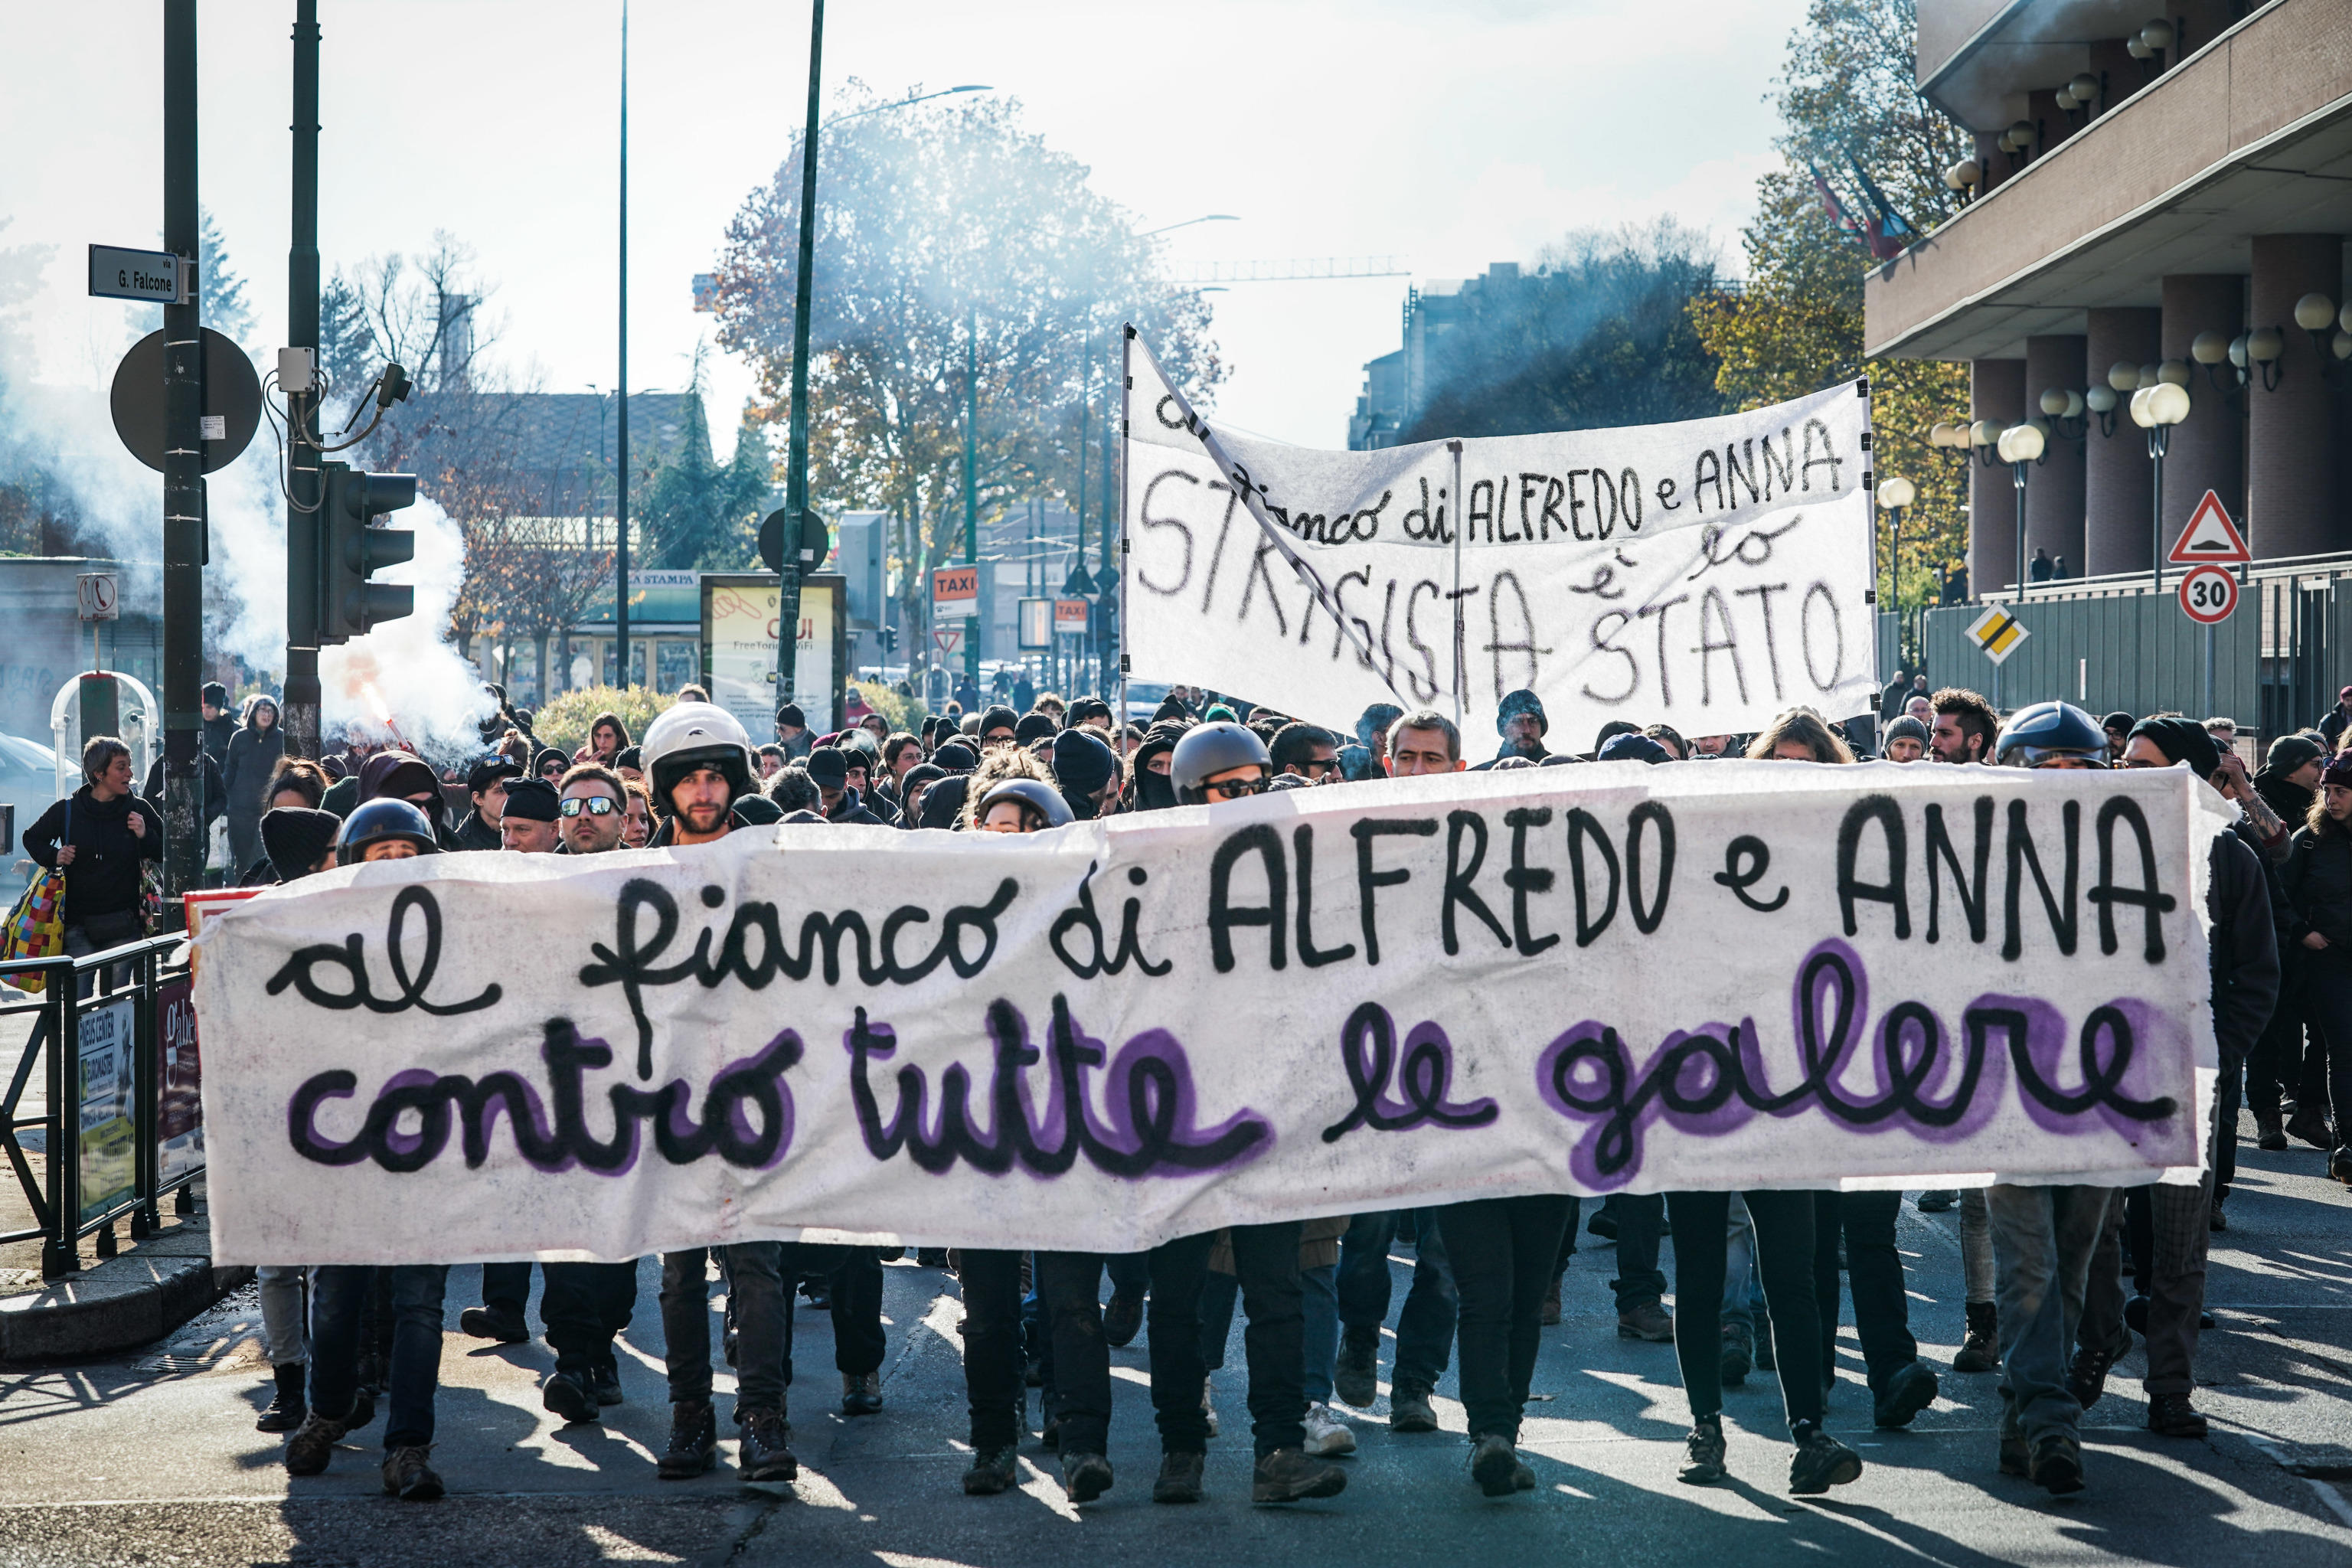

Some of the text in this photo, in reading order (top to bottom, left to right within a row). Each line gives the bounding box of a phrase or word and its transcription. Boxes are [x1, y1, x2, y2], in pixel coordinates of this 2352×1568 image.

[119, 270, 172, 292] G. Falcone
[1403, 477, 1454, 544] di
[1468, 467, 1642, 543] ALFREDO
[1655, 478, 1681, 510] e
[1694, 418, 1843, 513] ANNA
[1687, 514, 1804, 581] lo
[644, 575, 694, 585] STAMPA
[937, 577, 975, 593] TAXI
[2193, 581, 2226, 607] 30
[1058, 606, 1085, 616] TAXI
[1582, 580, 1844, 707] STATO
[266, 794, 2176, 1080] al fianco di ALFREDO e ANNA
[80, 1011, 114, 1049] PNEUS CENTER
[87, 1052, 113, 1083] EUROMASTER
[288, 938, 2179, 1191] contro tutte le galere
